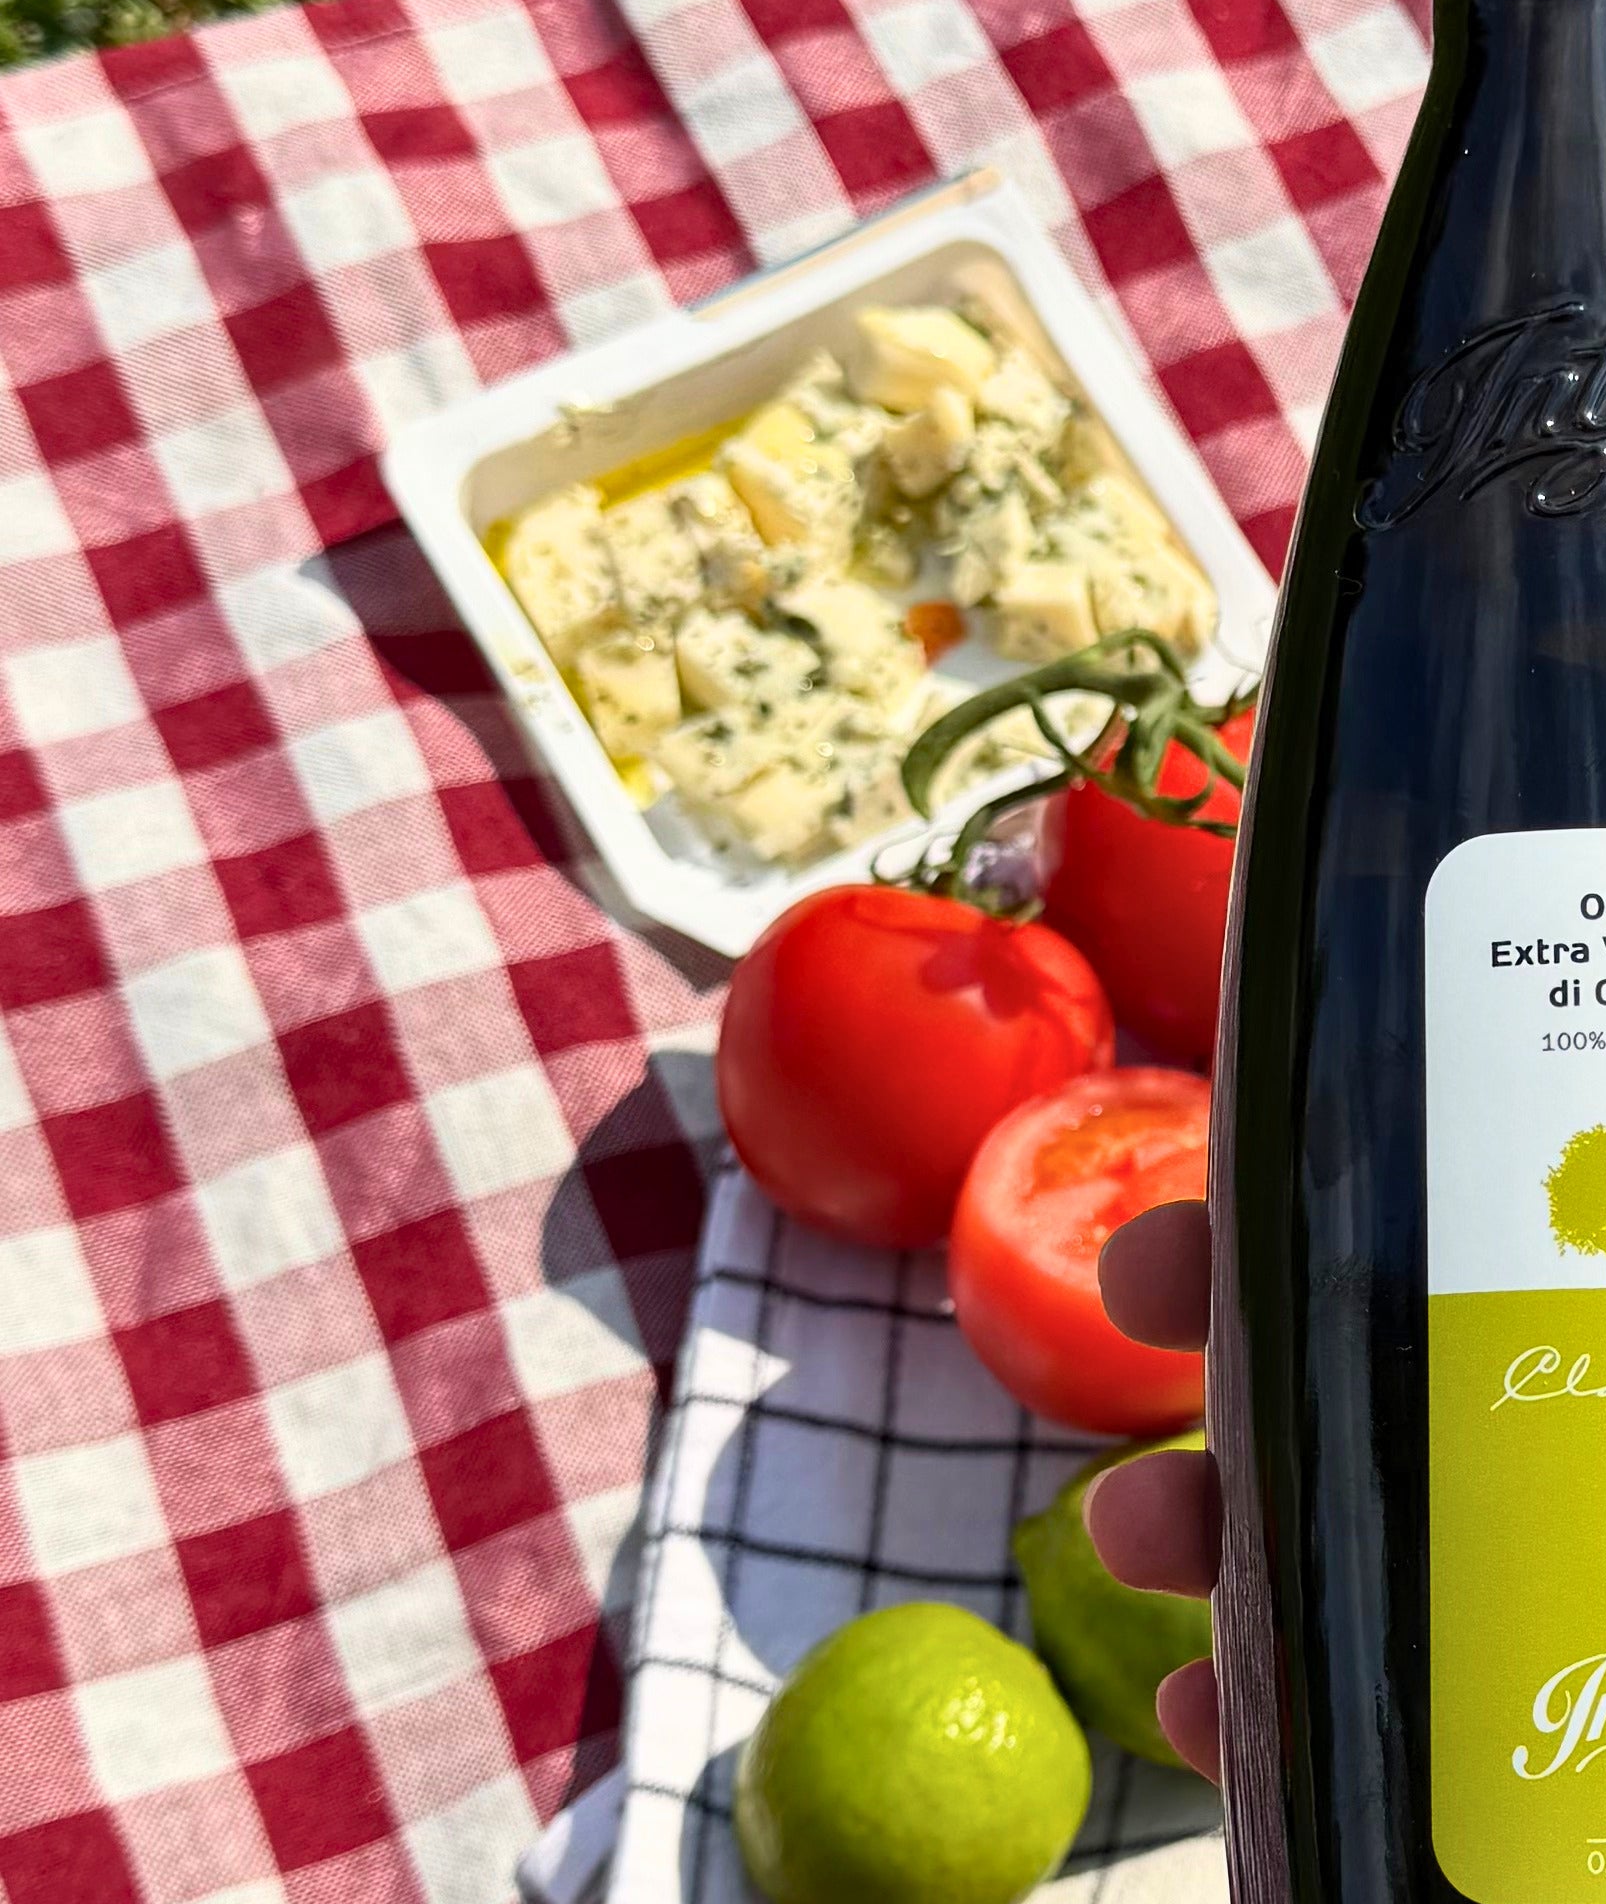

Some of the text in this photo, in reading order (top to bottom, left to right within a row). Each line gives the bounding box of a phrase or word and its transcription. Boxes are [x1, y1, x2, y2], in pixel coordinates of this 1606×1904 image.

[1491, 938, 1590, 968] Extra
[1549, 978, 1581, 1008] di
[1542, 1031, 1606, 1052] 100%
